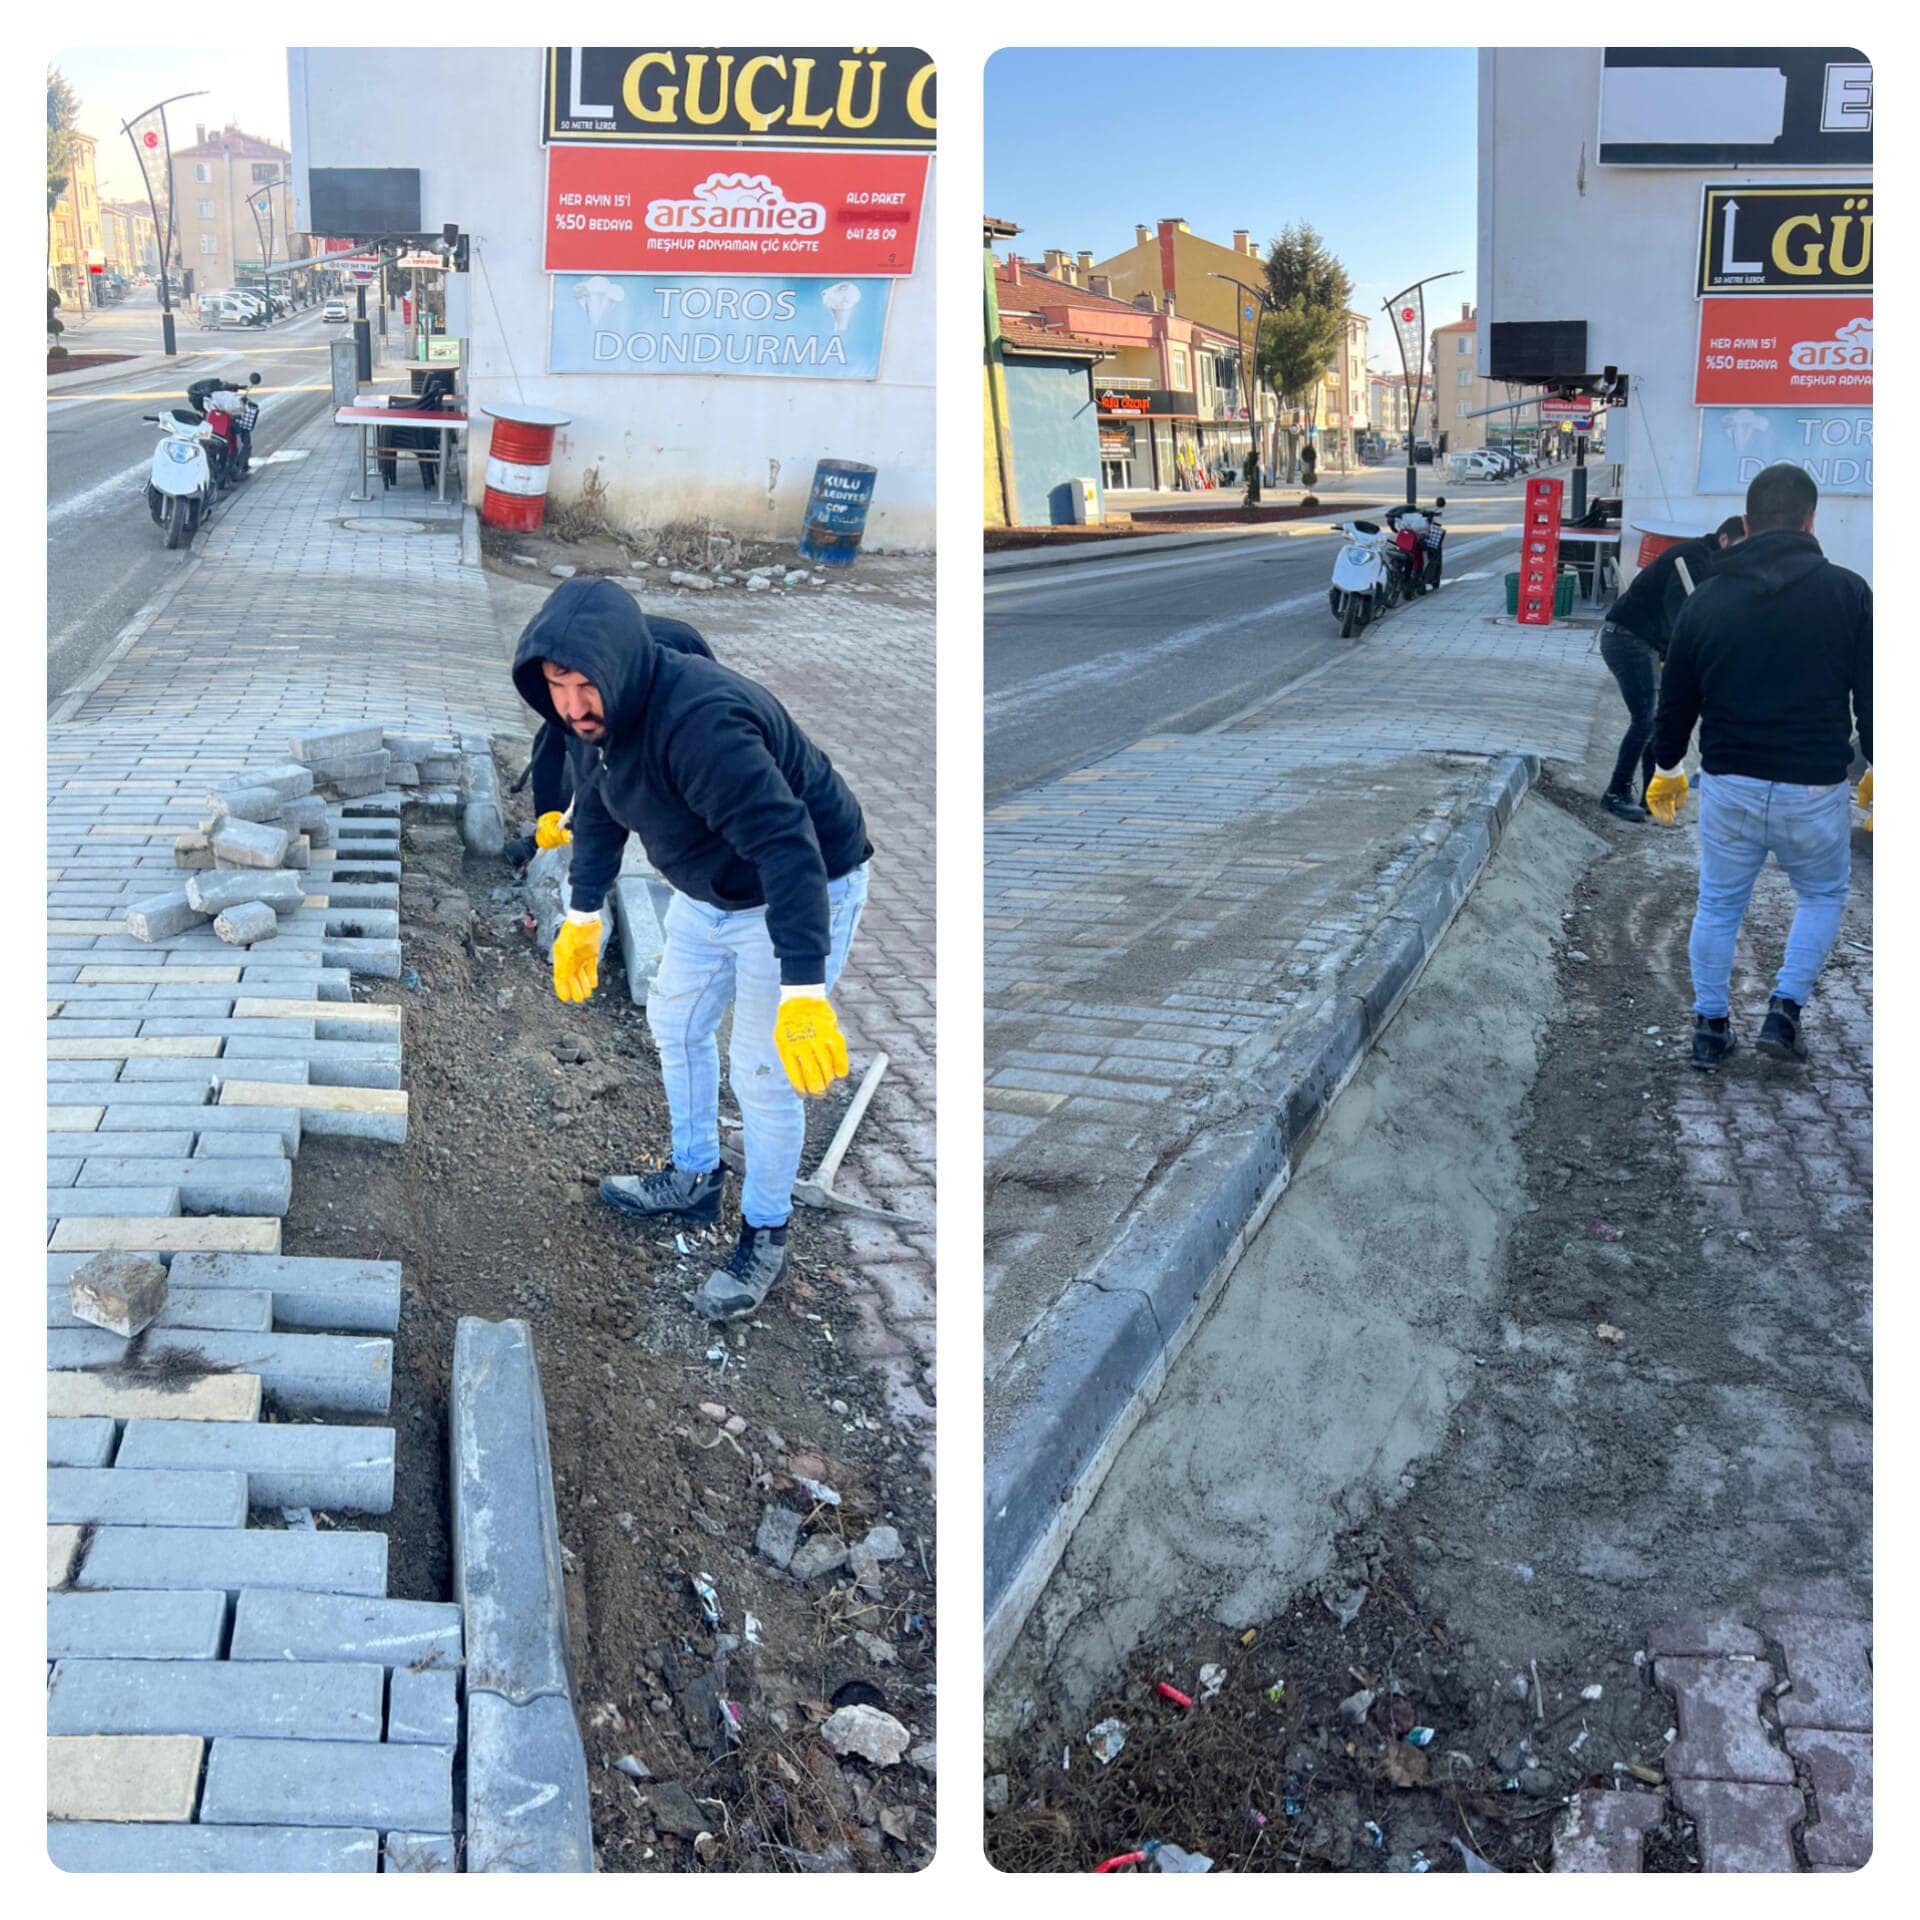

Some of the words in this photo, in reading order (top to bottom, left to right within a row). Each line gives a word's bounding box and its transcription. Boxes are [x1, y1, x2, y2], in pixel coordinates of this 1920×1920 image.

[560, 120, 570, 130] 50
[571, 120, 593, 130] METRE
[559, 194, 582, 206] HER
[585, 195, 611, 207] AYIN
[846, 193, 869, 205] ALO
[871, 193, 906, 205] PAKET
[653, 198, 818, 230] arsamiea
[555, 213, 586, 230] %50
[589, 219, 633, 231] BEDAVA
[846, 229, 864, 240] 641
[866, 229, 880, 240] 28
[882, 229, 897, 240] 09
[647, 238, 695, 252] MEŞHUR
[698, 238, 757, 251] ADIYAMAN
[782, 238, 819, 252] KÖFTE
[654, 287, 798, 321] TOROS
[592, 330, 849, 366] DONDURMA
[1710, 338, 1731, 349] HER
[1734, 338, 1758, 349] AYIN
[1705, 355, 1734, 370] %50
[1737, 359, 1778, 370] BEDAVA
[1797, 346, 1873, 366] arsa
[1790, 375, 1837, 388] MEŞHUR
[1838, 376, 1873, 386] ADIYA
[824, 475, 861, 490] KULU
